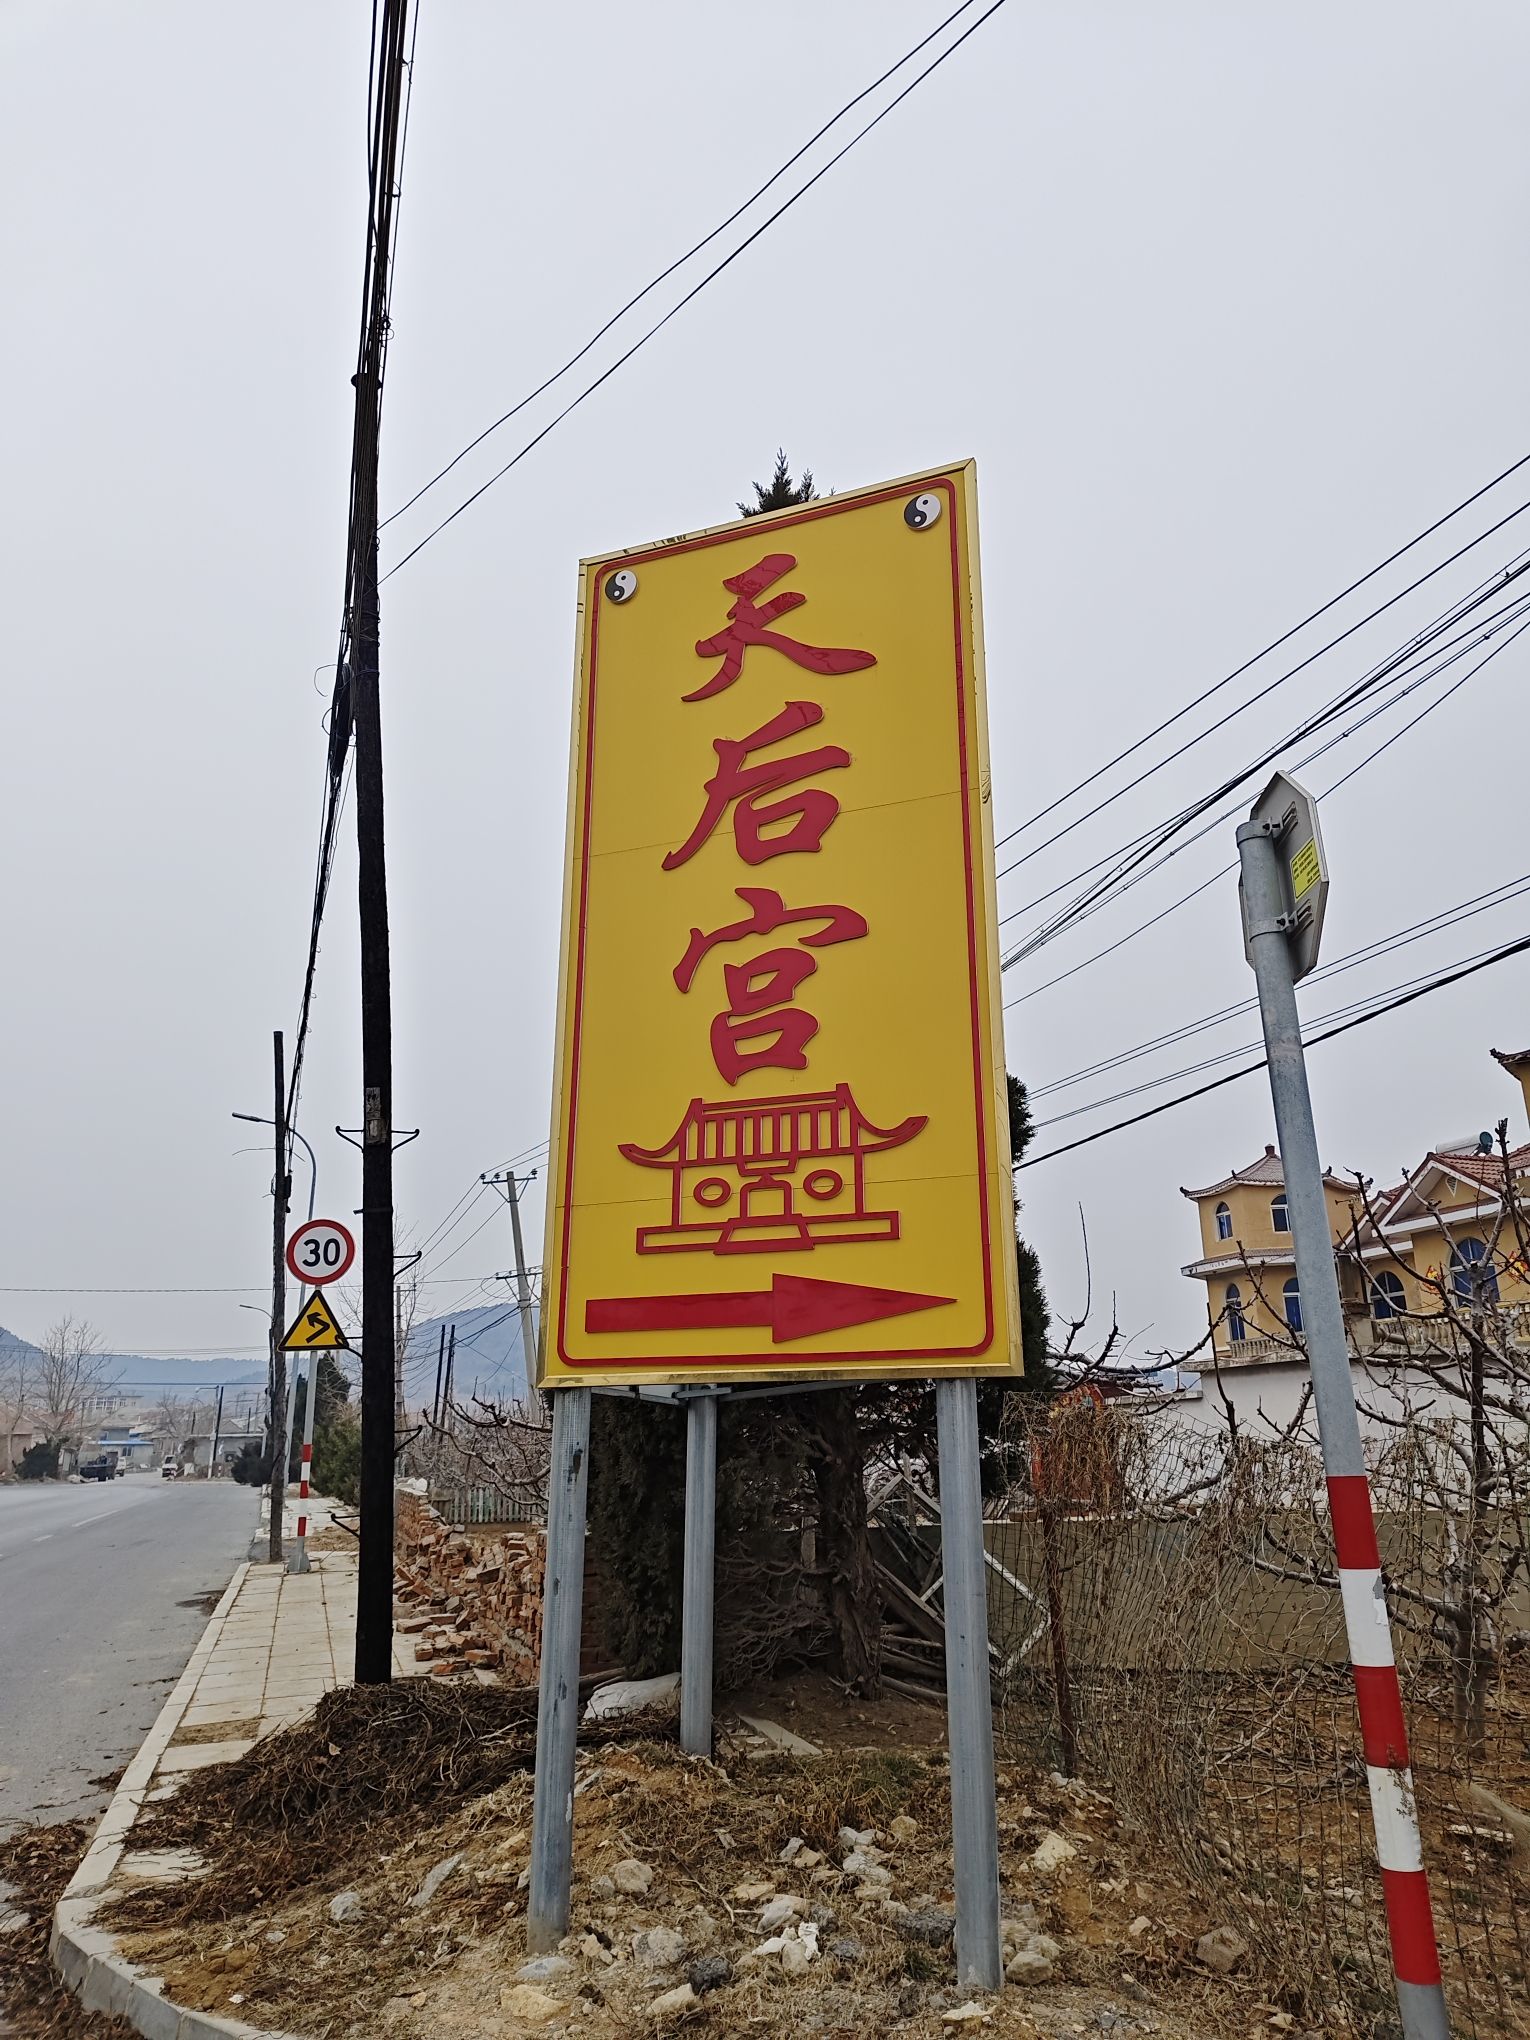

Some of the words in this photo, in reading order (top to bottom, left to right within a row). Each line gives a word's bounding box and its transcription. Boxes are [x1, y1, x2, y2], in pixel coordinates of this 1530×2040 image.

[661, 553, 877, 1087] 天后宫
[302, 1238, 341, 1267] 30
